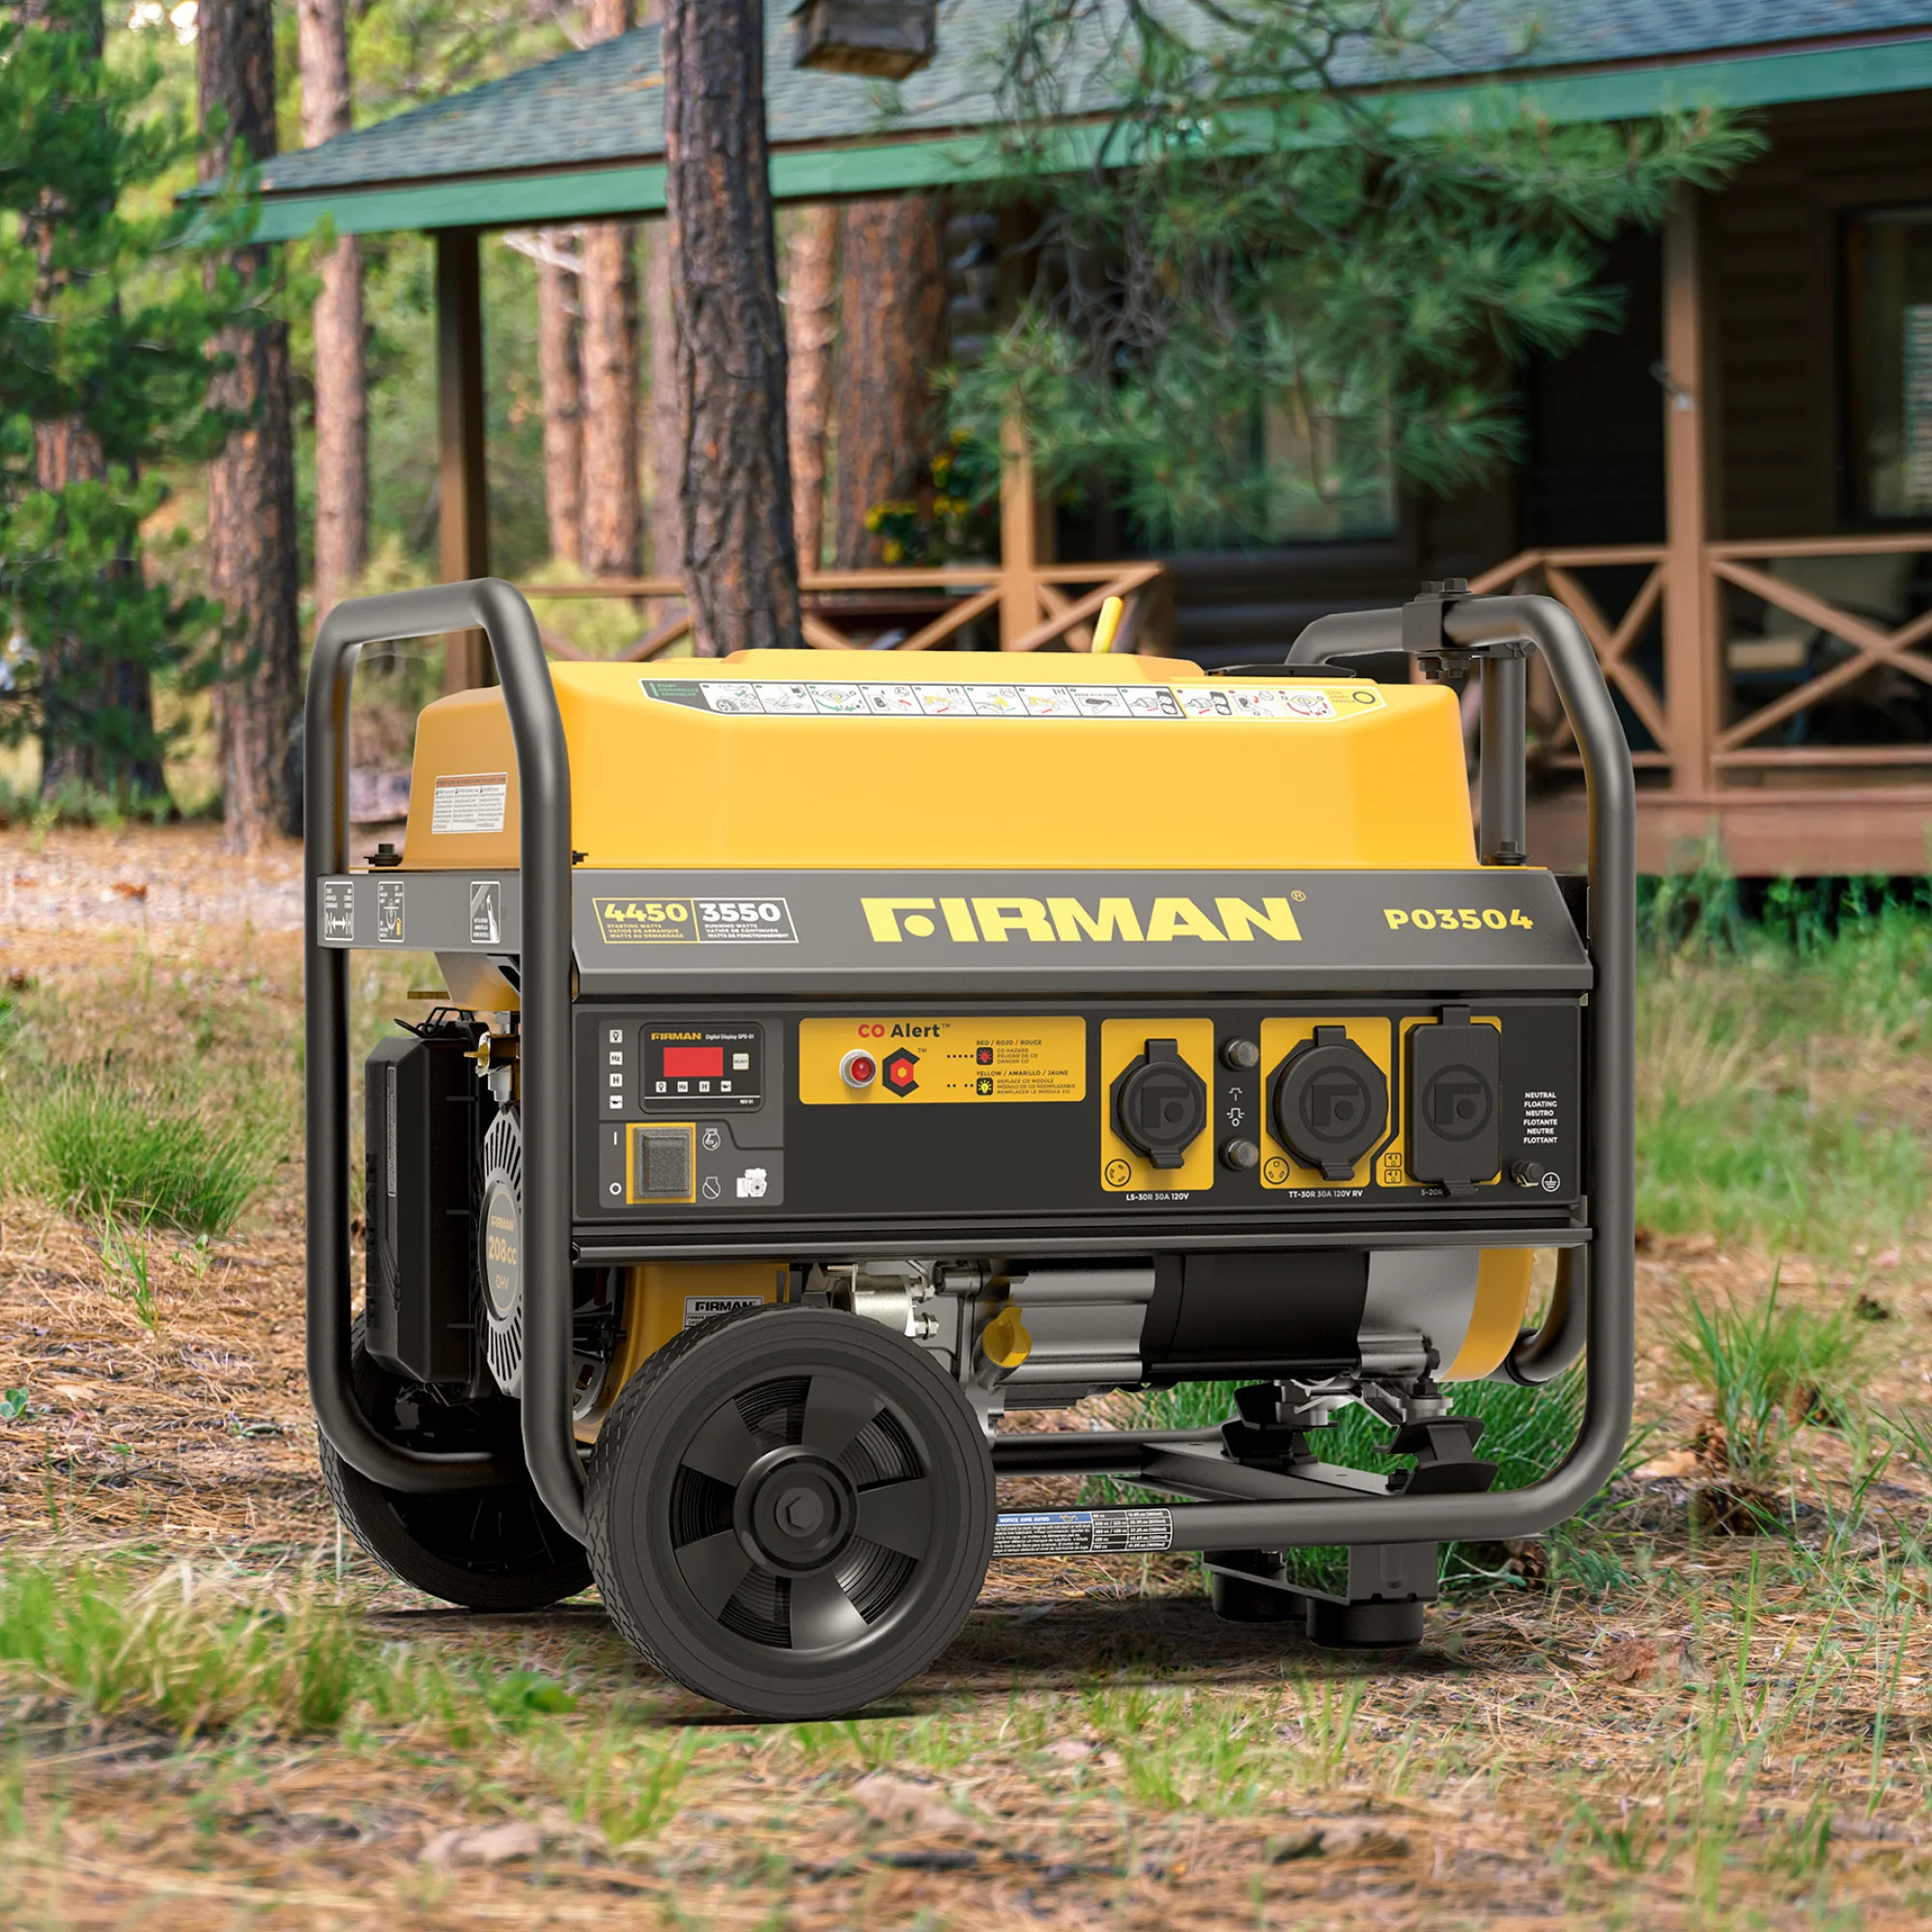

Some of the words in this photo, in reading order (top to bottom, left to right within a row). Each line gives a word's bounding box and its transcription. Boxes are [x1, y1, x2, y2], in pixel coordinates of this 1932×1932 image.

[604, 903, 688, 923] 4450
[698, 902, 781, 923] 3550
[860, 897, 1302, 942] FIRMAN
[858, 1024, 885, 1037] CO
[696, 1301, 753, 1312] FIRMAN
